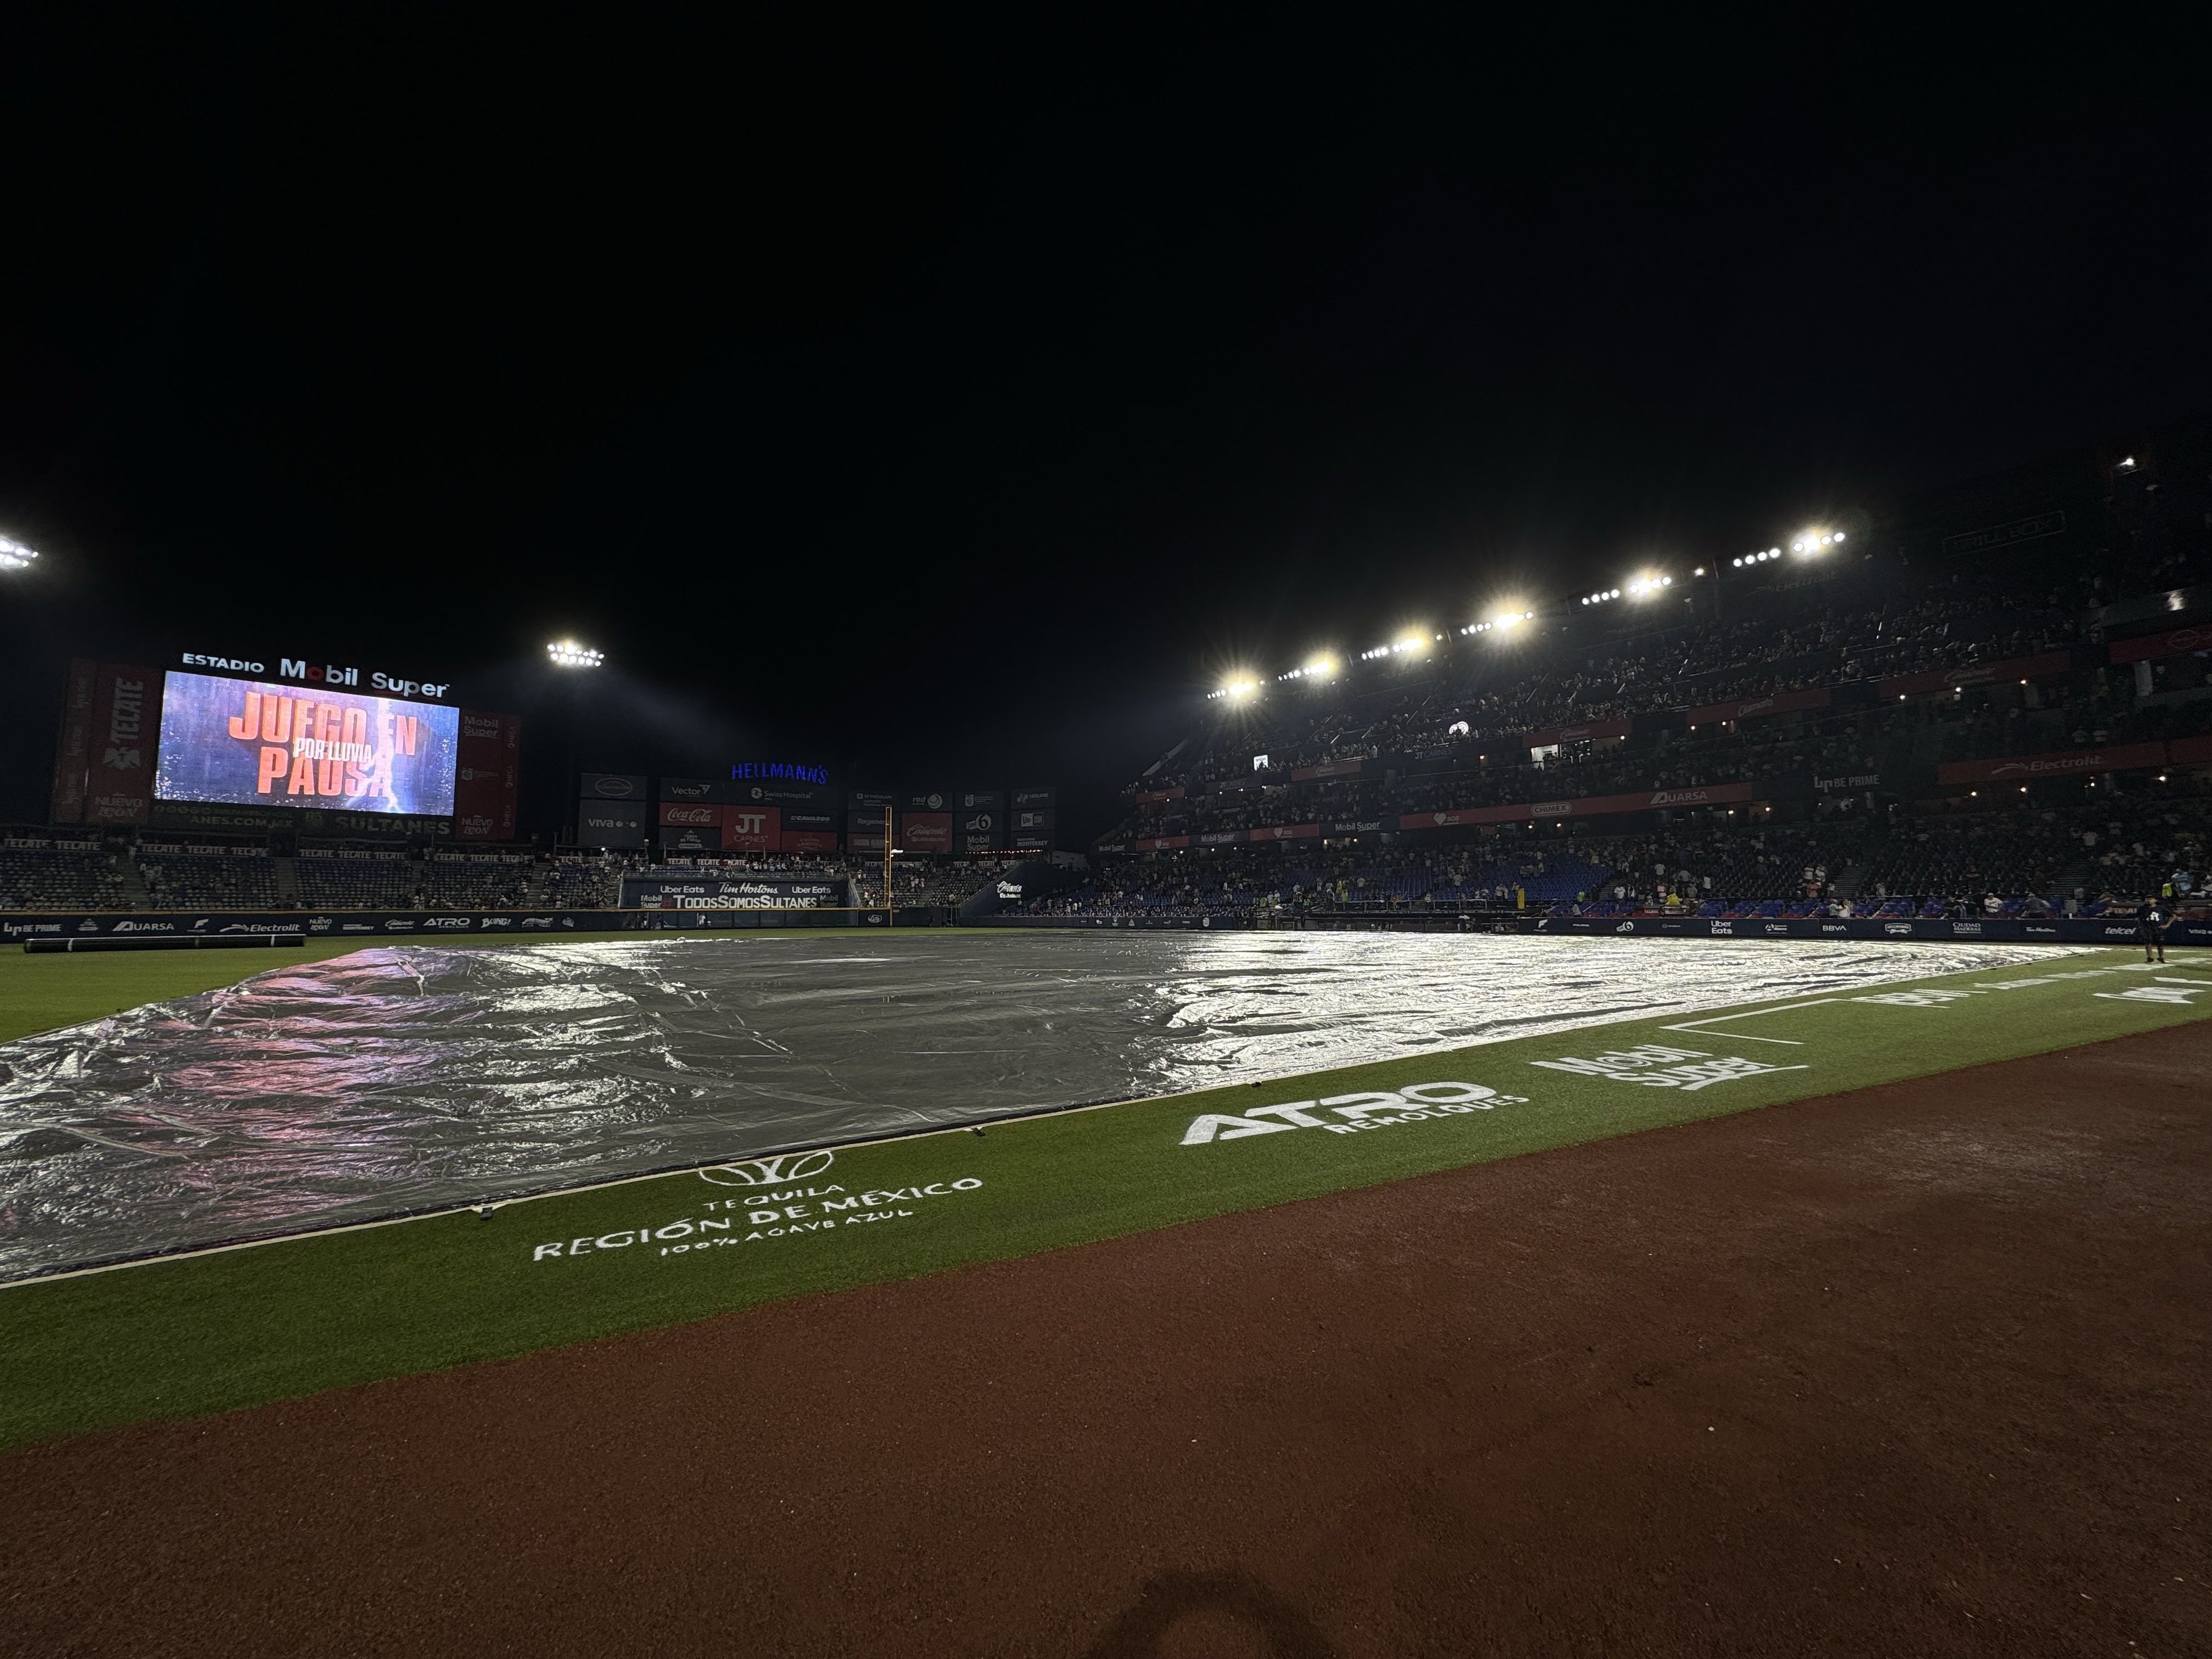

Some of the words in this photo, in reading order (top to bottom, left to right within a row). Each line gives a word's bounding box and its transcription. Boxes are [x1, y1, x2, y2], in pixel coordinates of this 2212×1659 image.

[183, 653, 264, 673] ESTADIO
[280, 659, 358, 686] Mobil
[371, 672, 447, 698] Super
[110, 676, 143, 744] TECATE
[229, 692, 367, 744] JUEGO
[379, 713, 417, 755] EN
[464, 716, 498, 727] Mobil
[464, 726, 498, 737] Super
[293, 737, 325, 759] POR
[327, 741, 372, 763] LLUVIA
[1415, 752, 1423, 760] JT
[1423, 748, 1452, 758] CARNES
[2031, 756, 2103, 771] Electrolit
[258, 746, 387, 798] PAUSA
[1834, 777, 1847, 787] BE
[1848, 775, 1880, 786] PRIME
[672, 786, 701, 795] Vector
[1534, 805, 1567, 813] CHIMEX
[335, 816, 450, 834] SULTANES
[735, 814, 766, 833] JT
[1335, 822, 1355, 831] Mobil
[1357, 821, 1380, 830] Super
[1201, 834, 1216, 842] Mobil
[1217, 833, 1234, 842] Super
[4, 838, 52, 849] TECATE
[54, 840, 101, 850] TECATE
[142, 844, 181, 853] TECATE
[185, 845, 227, 855] TECATE
[300, 849, 334, 857] TECATE
[337, 850, 371, 859] TECATE
[719, 882, 738, 893] Tim
[739, 882, 778, 894] Hortons
[423, 917, 471, 926] ATRO
[35, 924, 61, 932] PRIME
[250, 924, 301, 932] Electrolit
[2104, 927, 2136, 935] telcel
[1530, 1044, 1714, 1076] Mobil
[1606, 1057, 1776, 1087] Super
[1178, 1081, 1497, 1145] ATRO
[1323, 1094, 1530, 1134] REMOLQUES
[703, 1184, 845, 1211] TEQUILA
[532, 1217, 731, 1262] REGIÓN
[749, 1204, 812, 1226] DE
[823, 1177, 984, 1214] MÉXICO
[661, 1237, 738, 1257] 100%
[745, 1219, 836, 1241] AGAVE
[846, 1210, 914, 1224] AZUL
